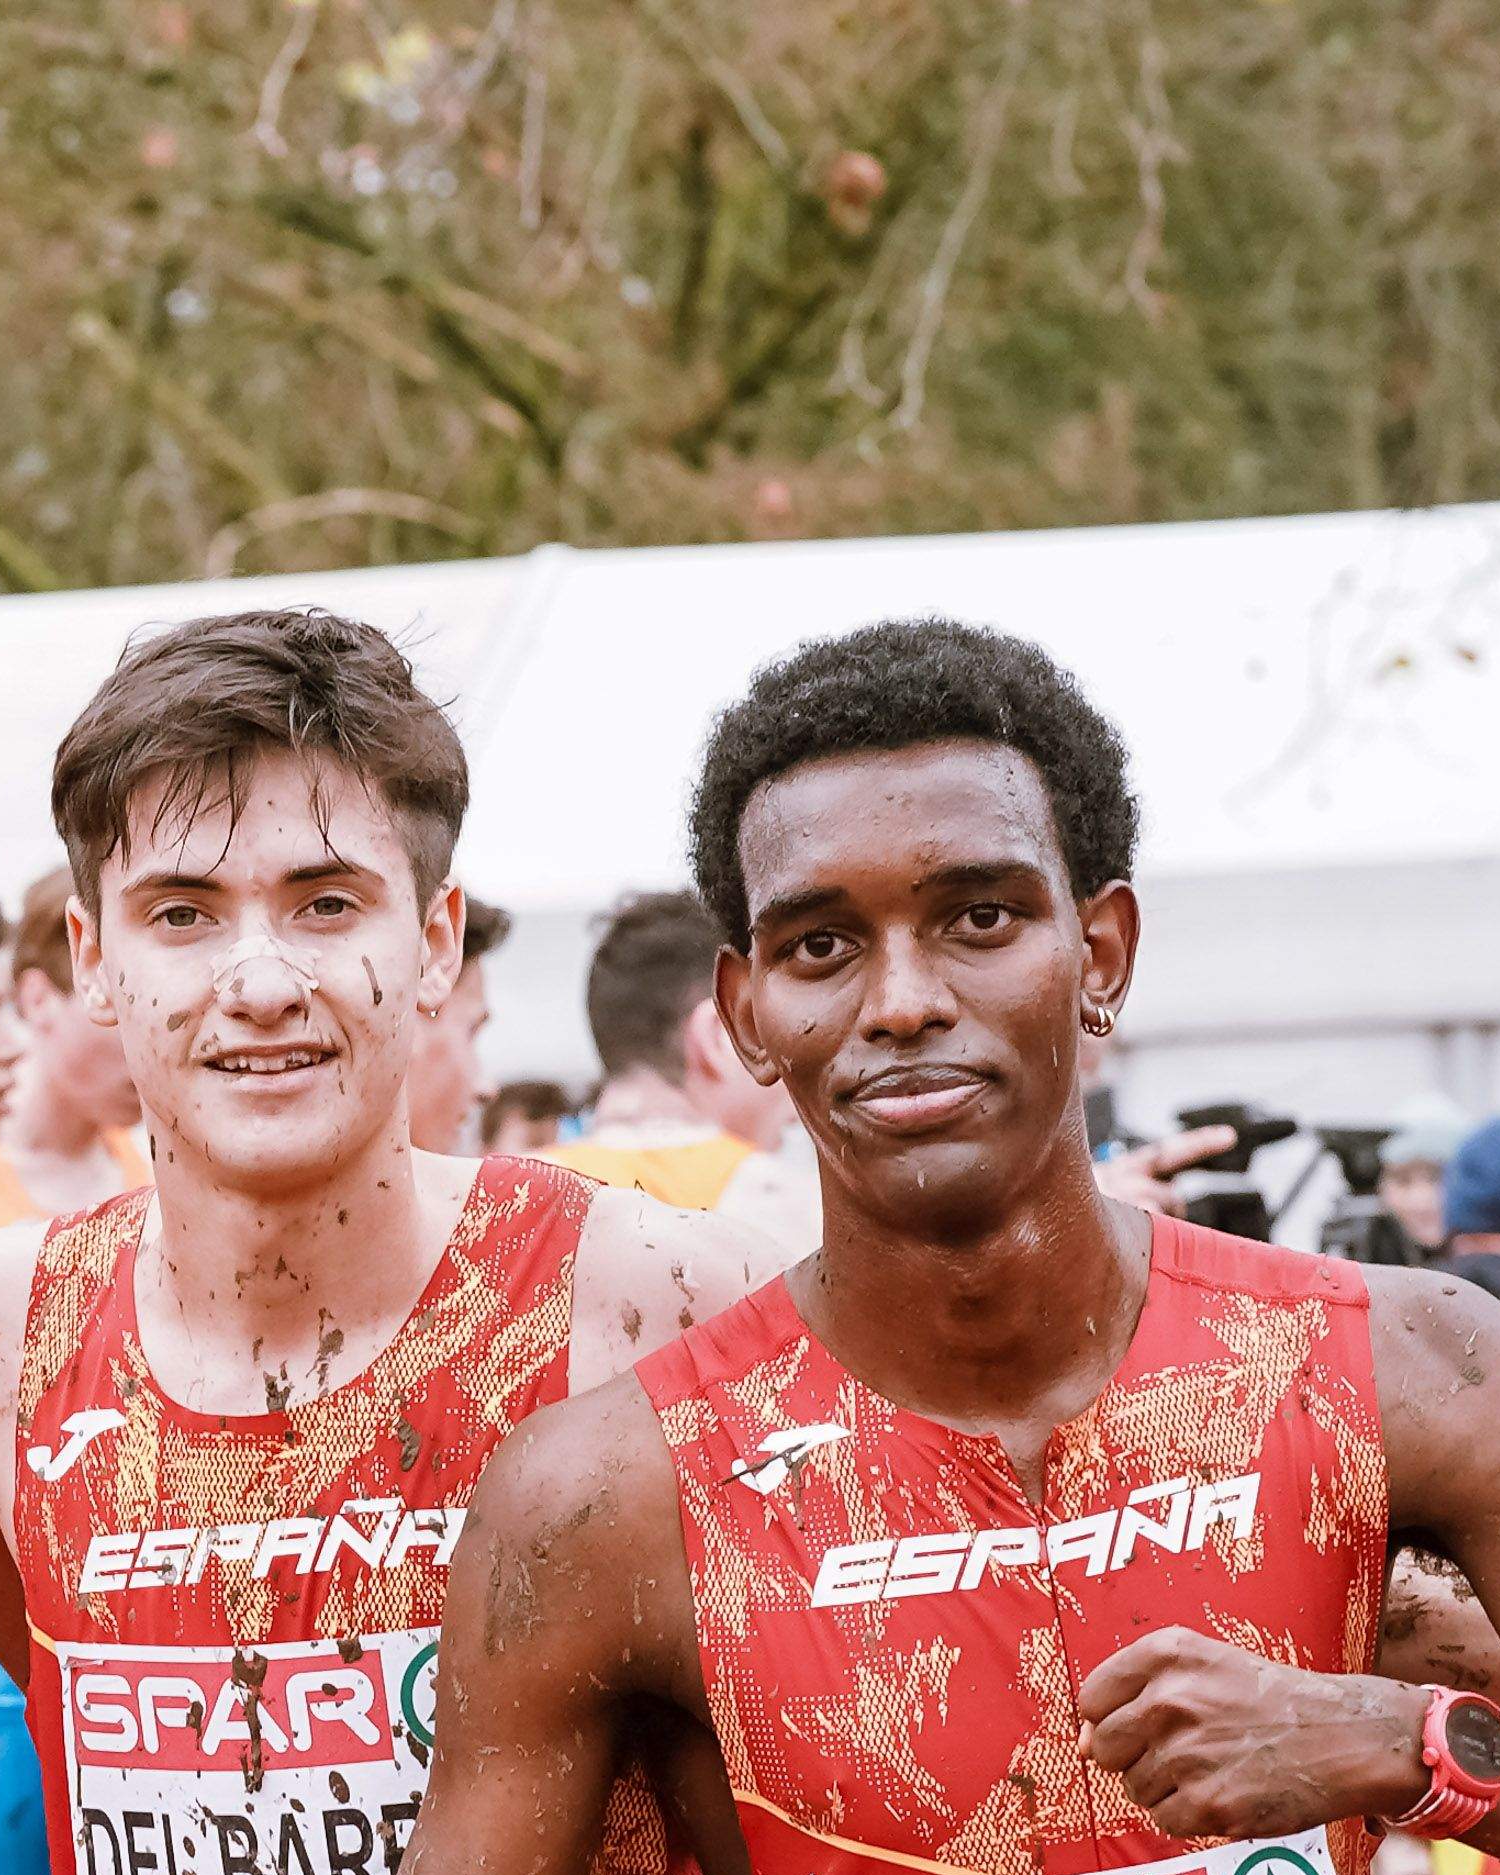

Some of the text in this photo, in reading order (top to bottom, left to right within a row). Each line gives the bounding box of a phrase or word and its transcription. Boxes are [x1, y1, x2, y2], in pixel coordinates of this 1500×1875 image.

[78, 1496, 468, 1593] ESPAÑA
[811, 1472, 1261, 1608] ESPAÑA
[75, 1668, 380, 1756] SPAR
